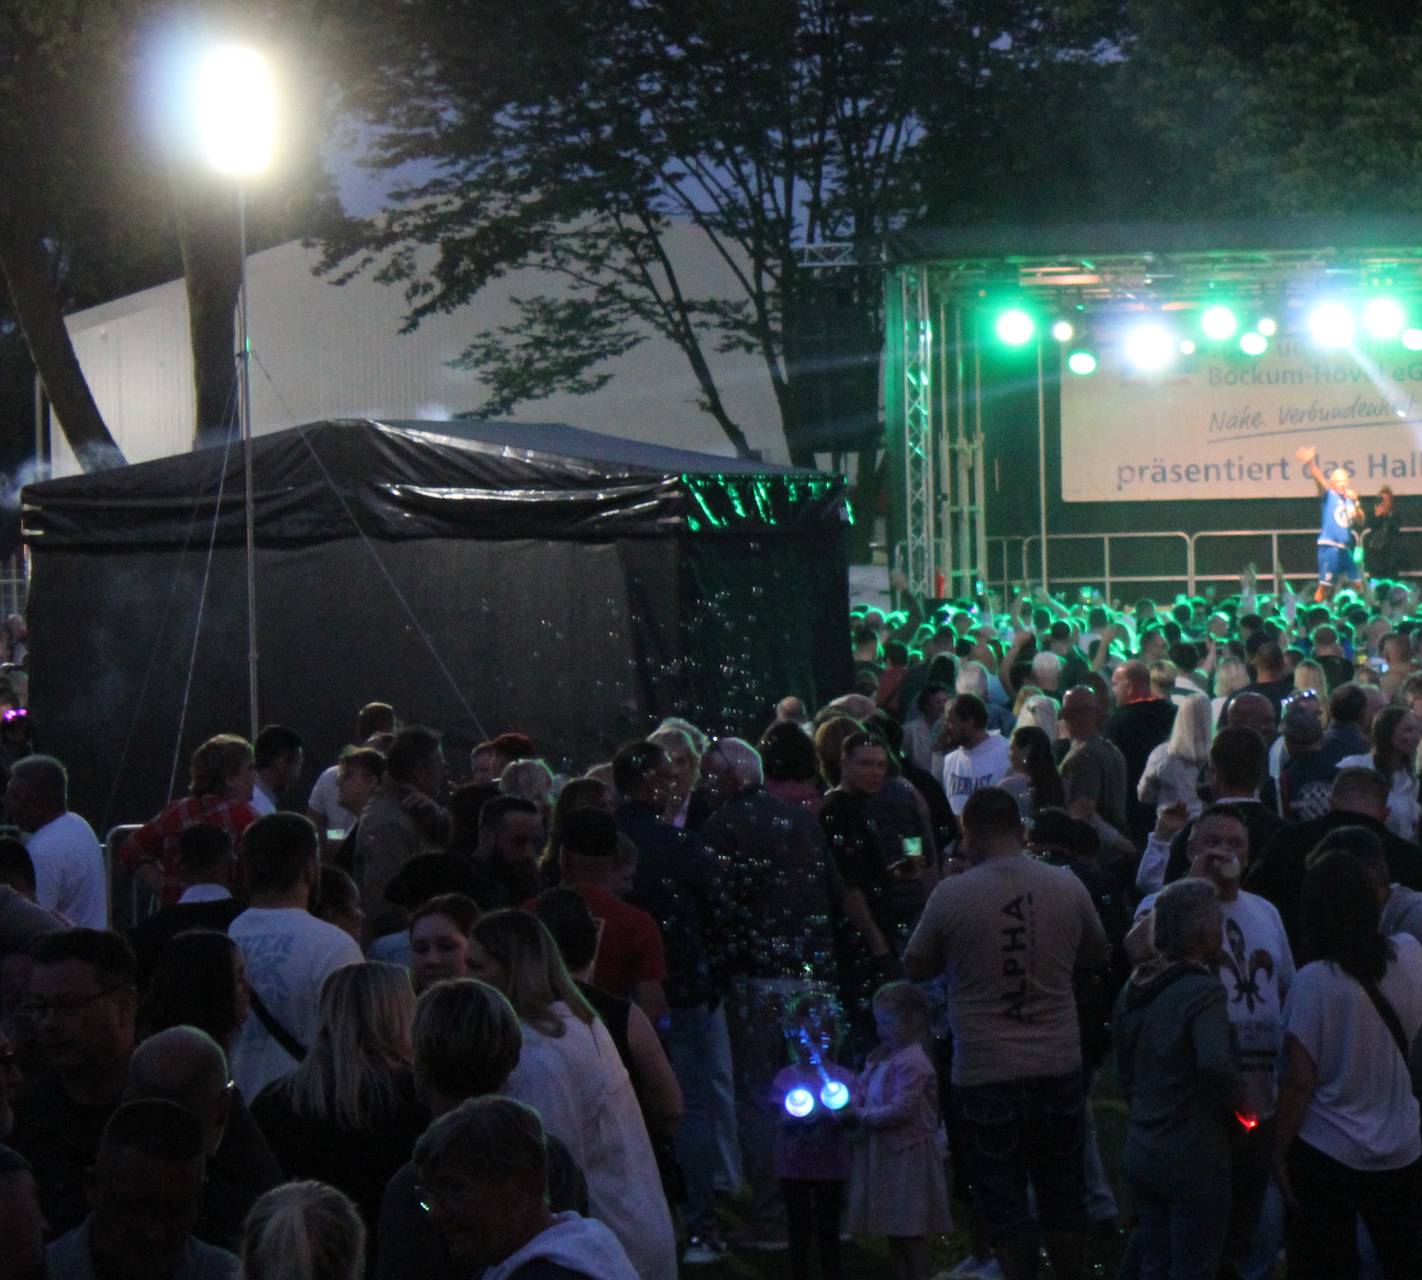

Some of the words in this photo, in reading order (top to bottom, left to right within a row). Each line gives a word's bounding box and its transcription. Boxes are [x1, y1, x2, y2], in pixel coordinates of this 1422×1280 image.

[1116, 455, 1291, 491] präsentiert
[1302, 453, 1356, 481] das
[1000, 894, 1026, 1023] ALPHA
